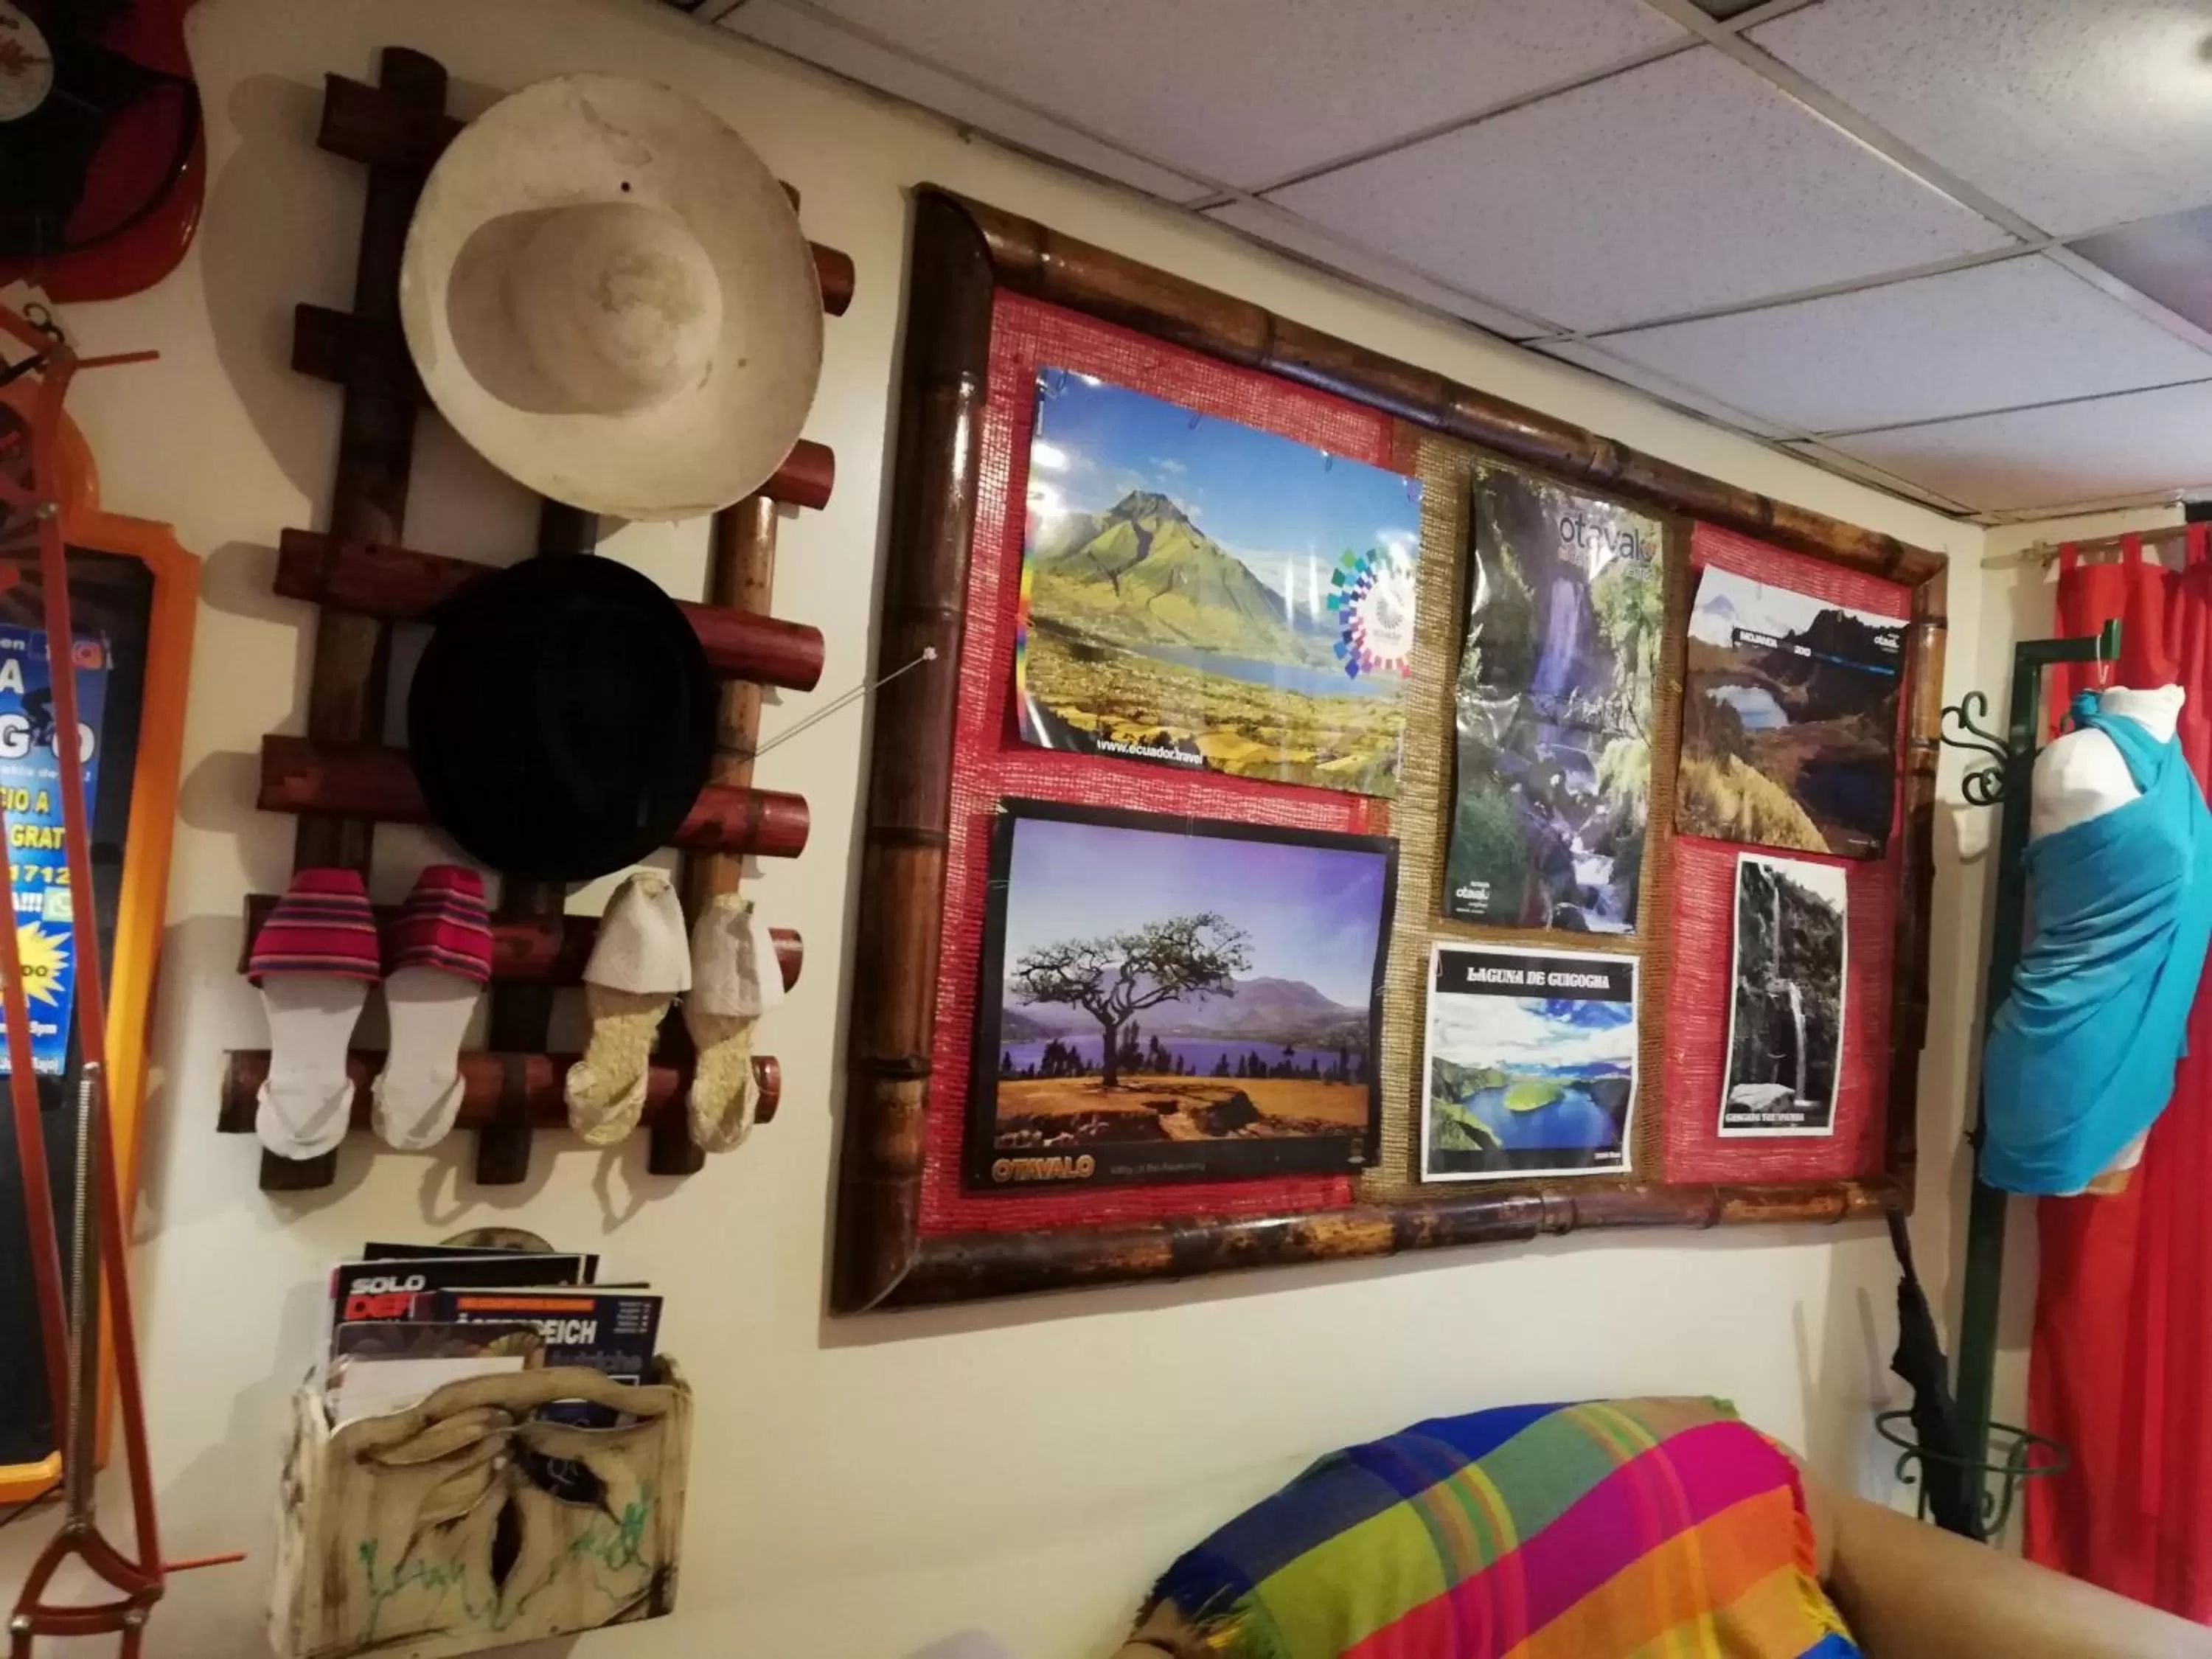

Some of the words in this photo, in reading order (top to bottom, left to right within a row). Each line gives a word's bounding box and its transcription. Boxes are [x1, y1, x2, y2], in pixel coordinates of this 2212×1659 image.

[1096, 739, 1204, 765] www.ecuador.travel
[1466, 967, 1524, 984] LAGUNA
[1526, 971, 1546, 986] DE
[992, 1154, 1096, 1182] OTAVALO
[349, 1275, 426, 1295] SOLO
